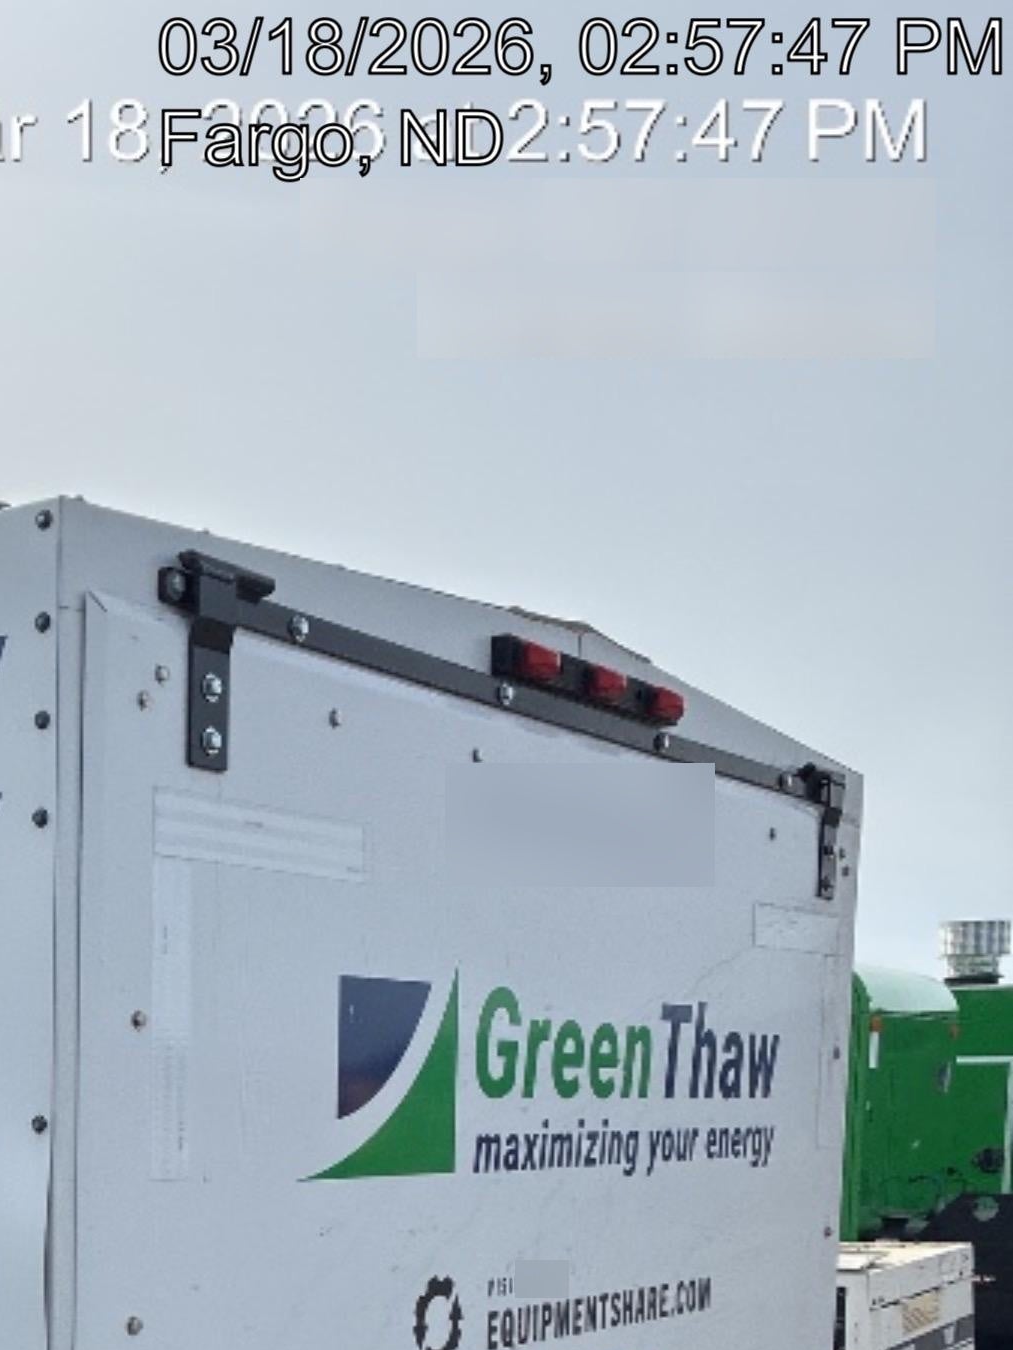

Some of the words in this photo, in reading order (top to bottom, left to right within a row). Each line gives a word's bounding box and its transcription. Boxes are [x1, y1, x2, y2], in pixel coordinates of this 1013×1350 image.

[472, 1117, 640, 1177] maximizing
[646, 1125, 700, 1177] your
[705, 1124, 776, 1168] energy
[486, 1276, 712, 1350] EQUIPMENTSHARE.COM
